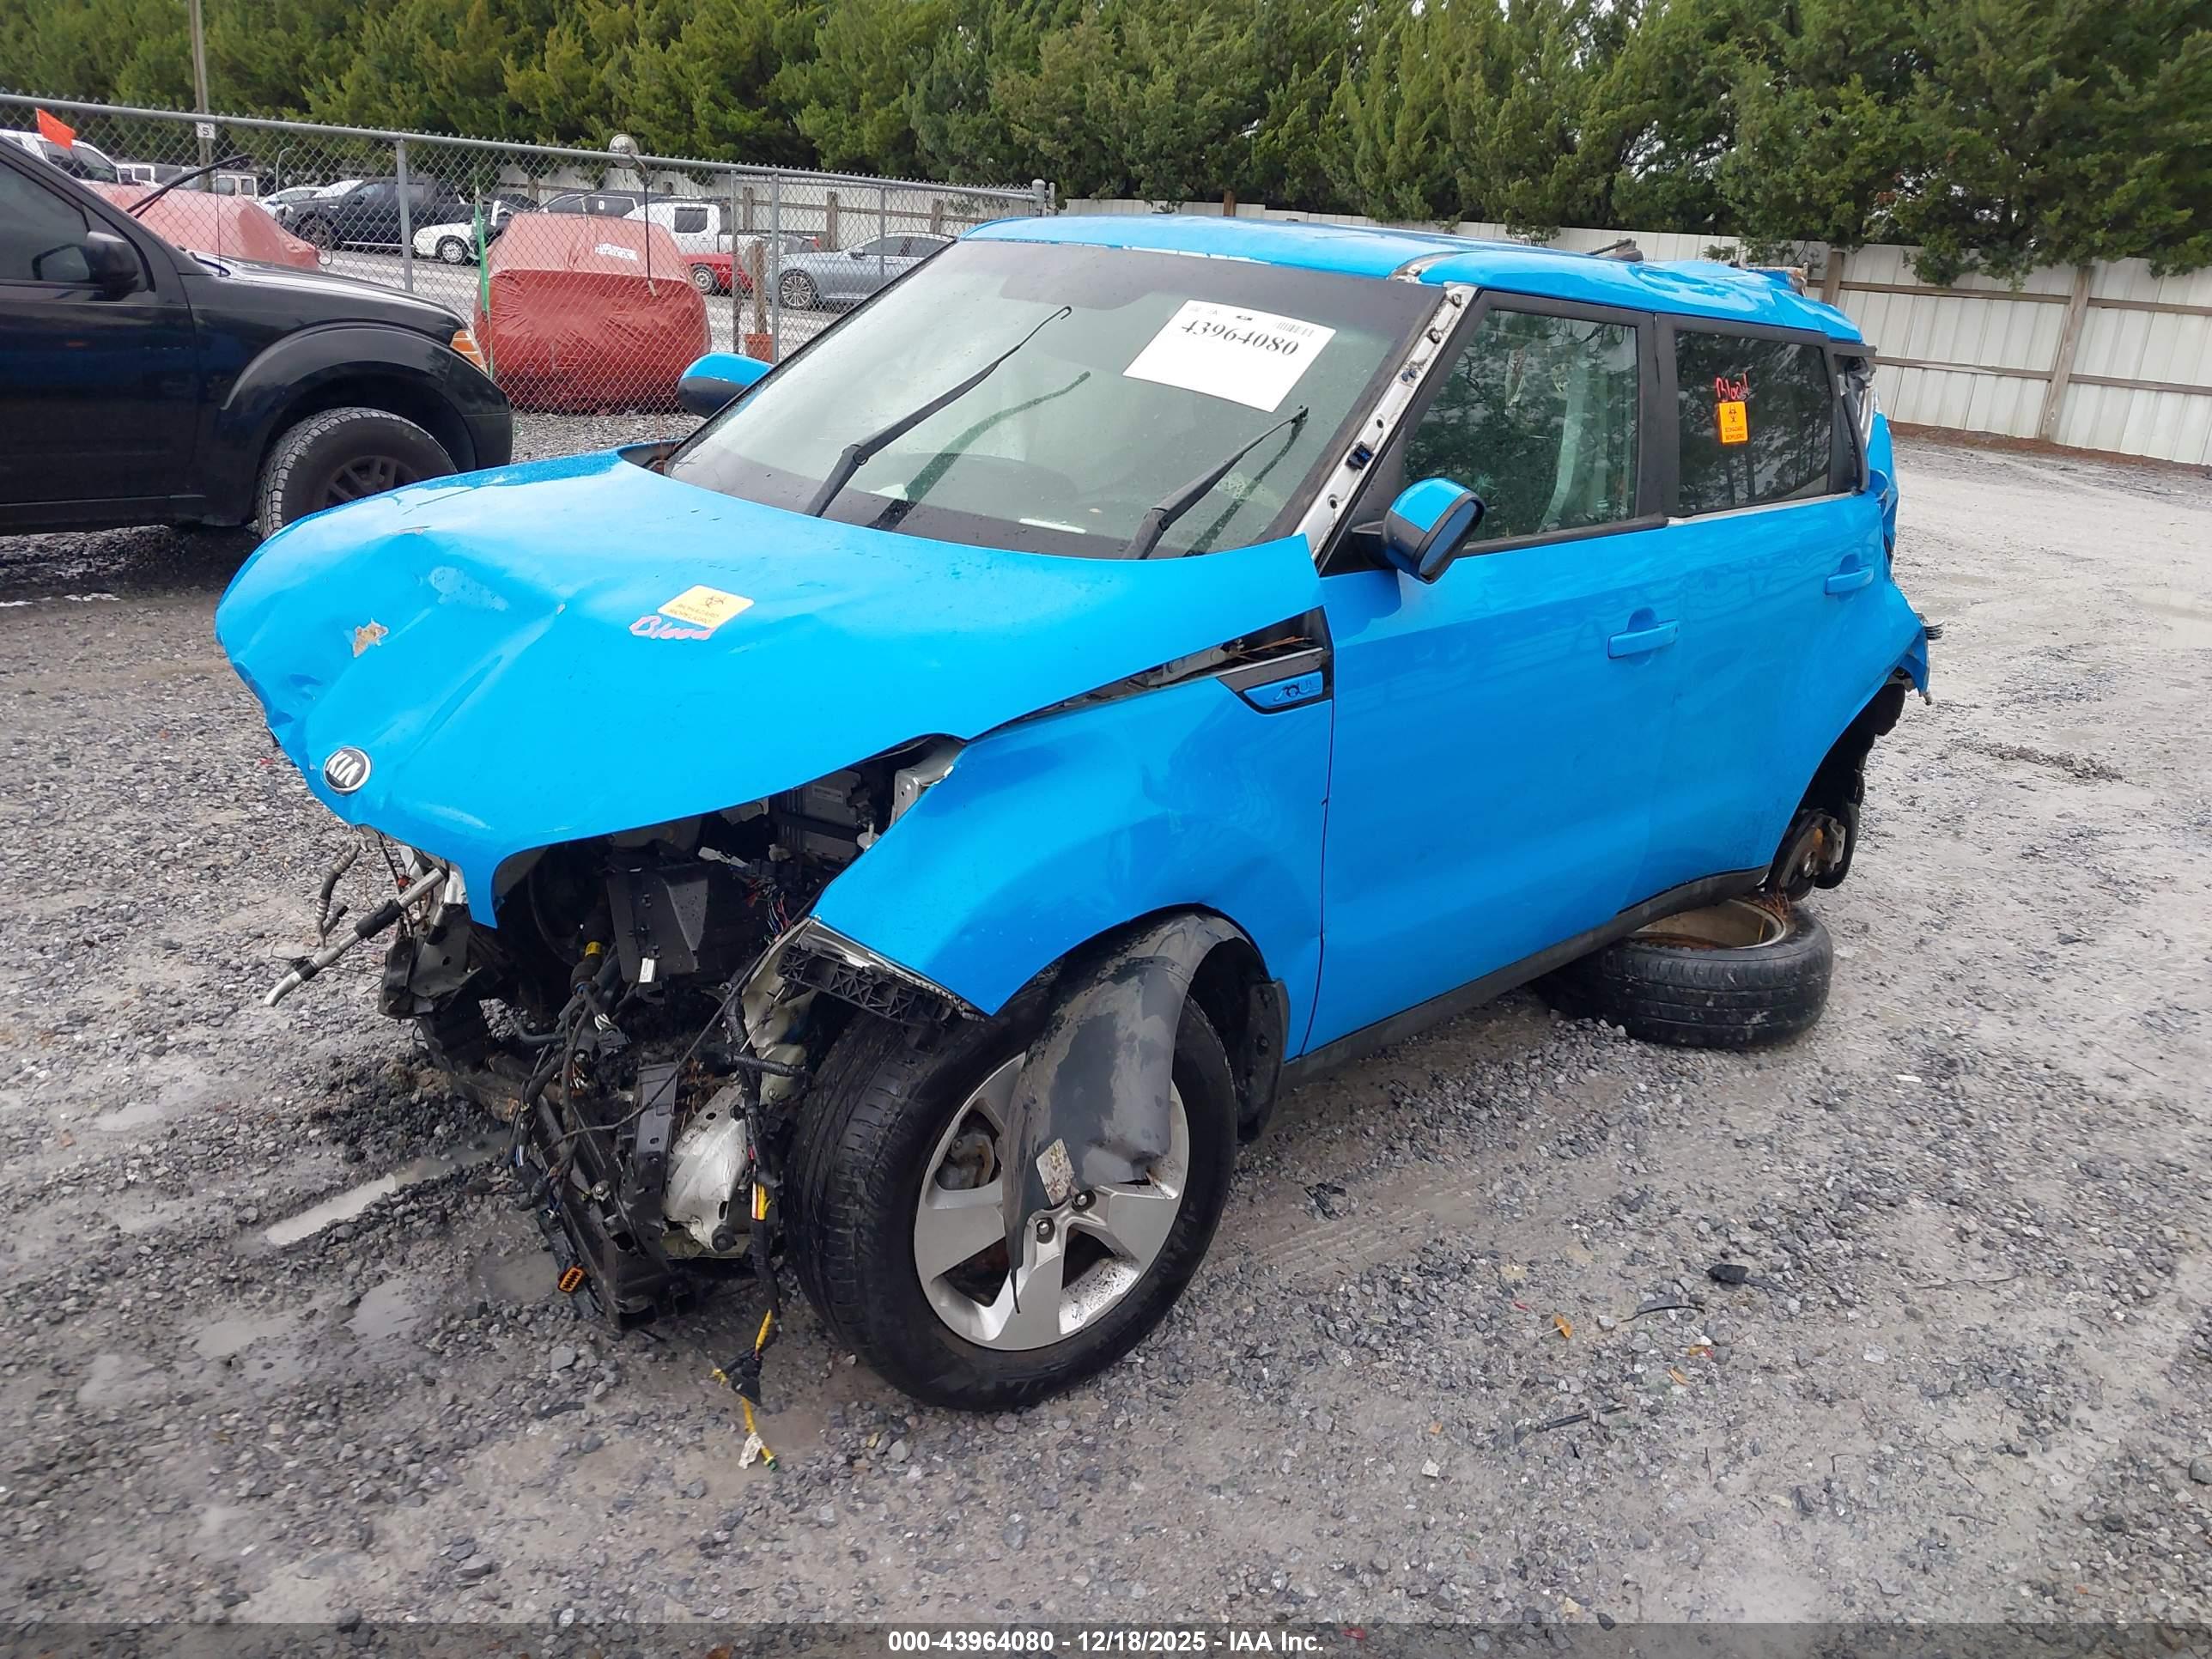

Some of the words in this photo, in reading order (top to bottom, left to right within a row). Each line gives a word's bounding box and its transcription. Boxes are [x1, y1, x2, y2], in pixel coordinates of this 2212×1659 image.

[202, 126, 210, 137] S
[1181, 319, 1299, 356] 43964080
[325, 751, 362, 787] KIA
